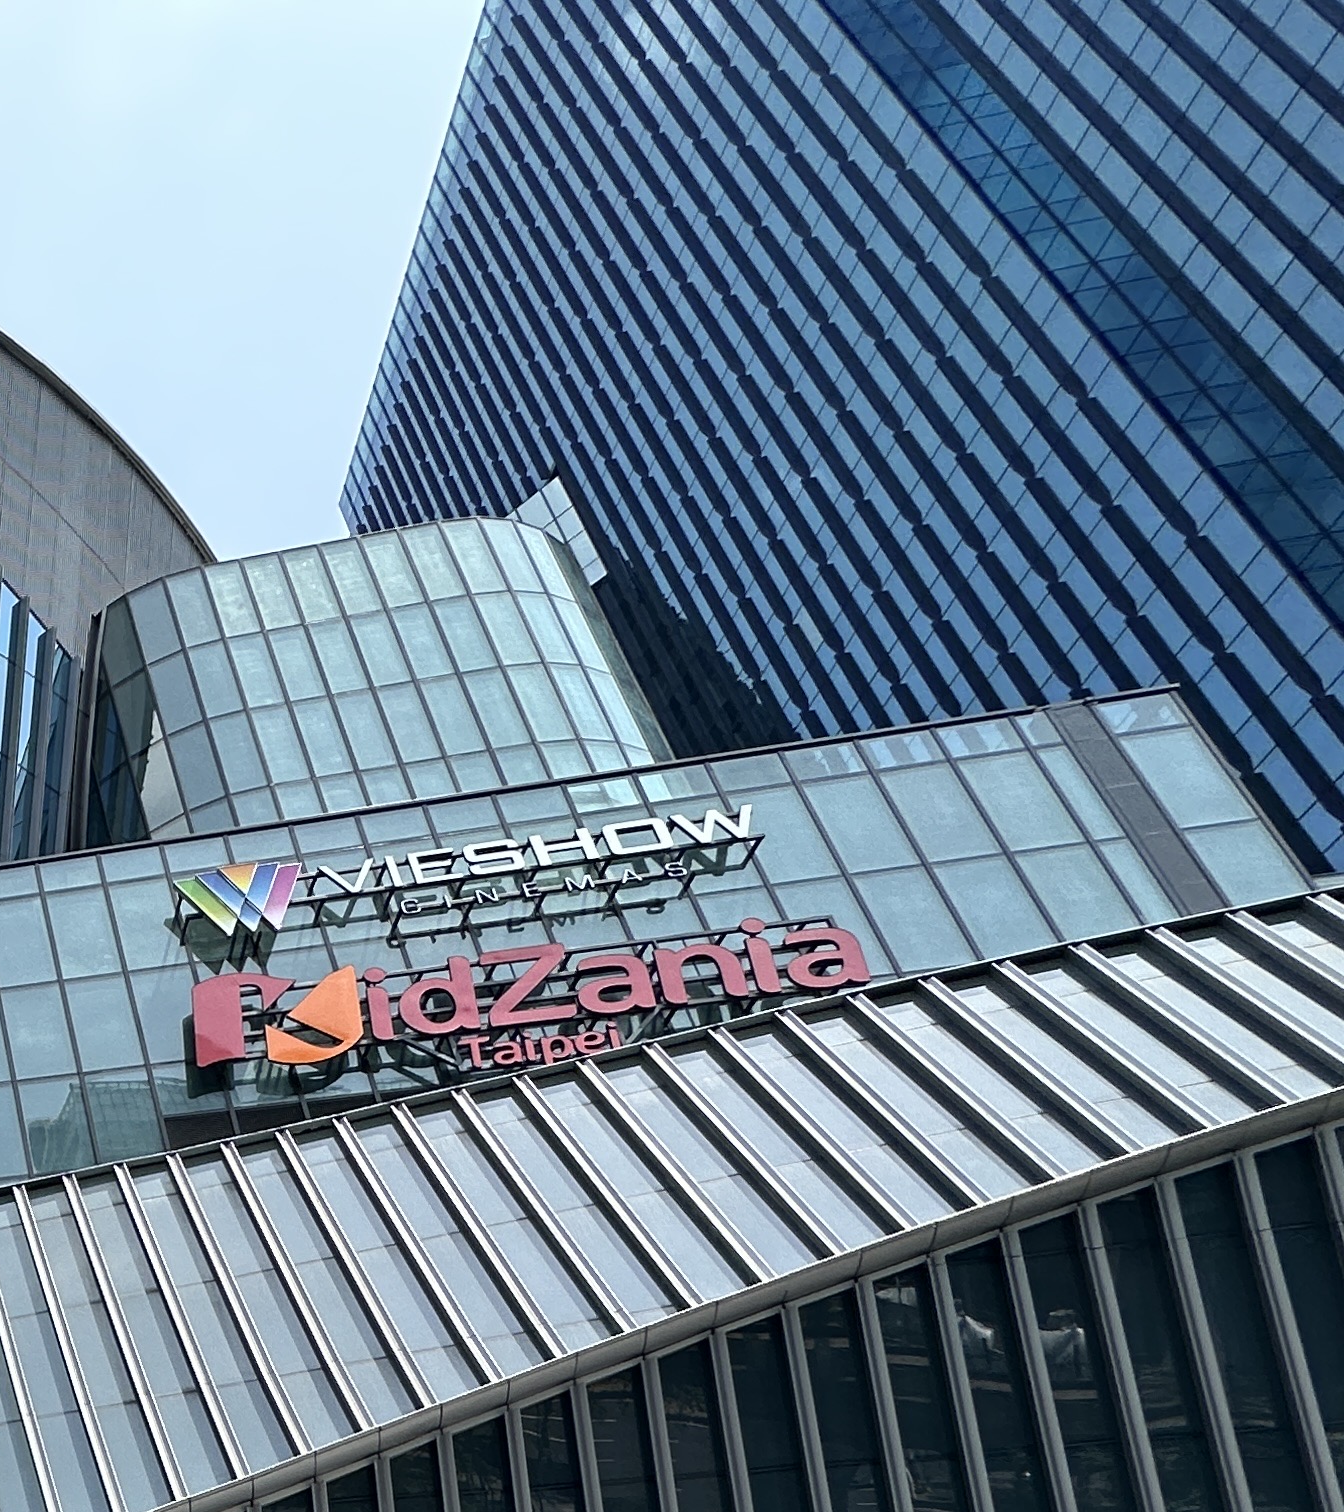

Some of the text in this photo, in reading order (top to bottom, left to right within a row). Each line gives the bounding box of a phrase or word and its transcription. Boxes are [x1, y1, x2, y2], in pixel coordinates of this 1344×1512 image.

[317, 803, 754, 894] VIESHOW
[400, 860, 688, 914] CINEMAS
[191, 917, 871, 1067] KidZania
[457, 1021, 622, 1068] Taipei
